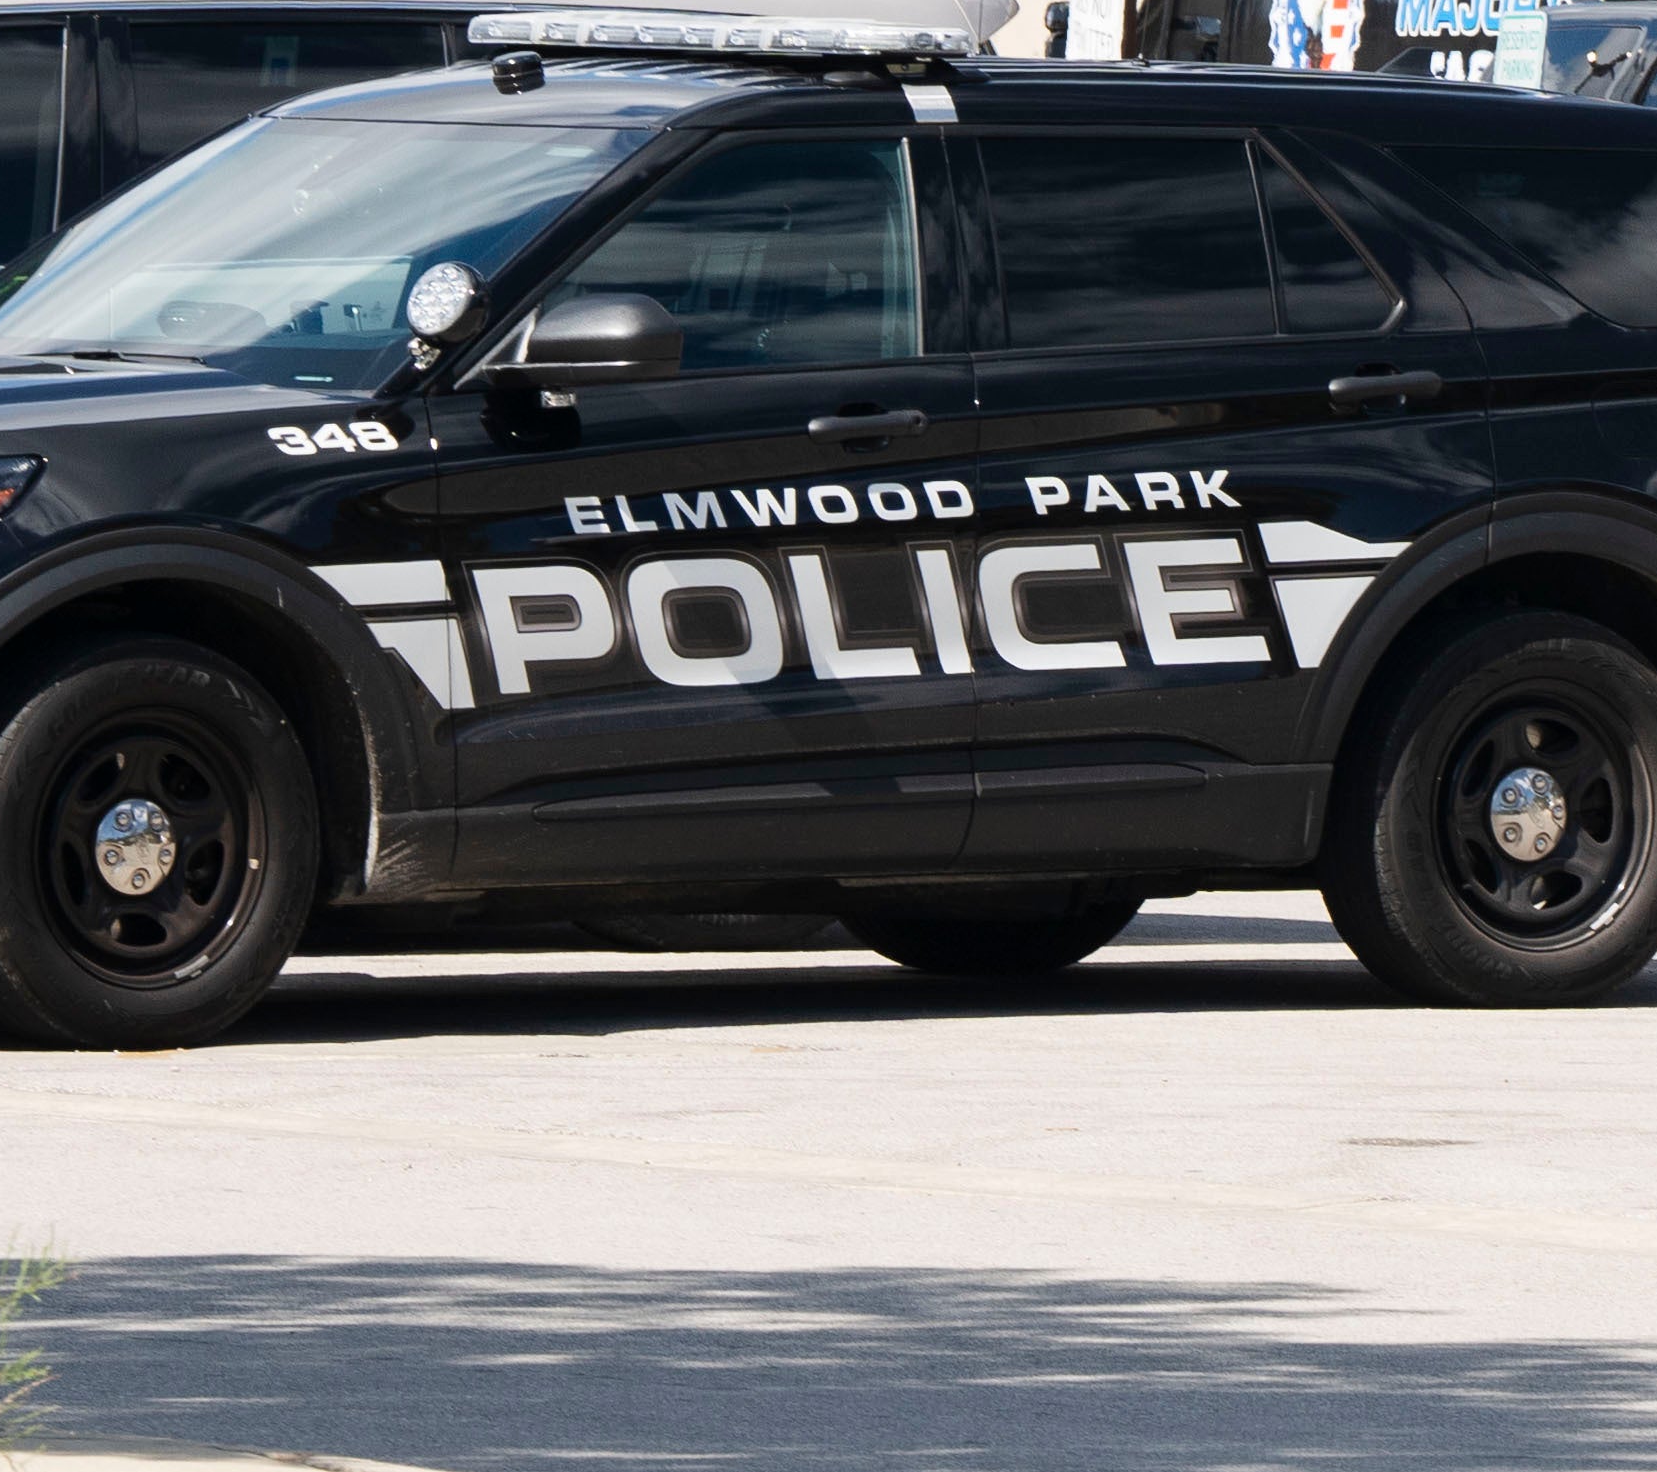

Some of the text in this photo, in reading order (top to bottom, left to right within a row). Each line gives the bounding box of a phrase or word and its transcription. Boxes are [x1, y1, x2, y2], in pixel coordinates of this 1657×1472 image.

[267, 421, 399, 458] 348
[566, 468, 1242, 538] ELMWOOD PARK
[466, 537, 1276, 696] POLICE
